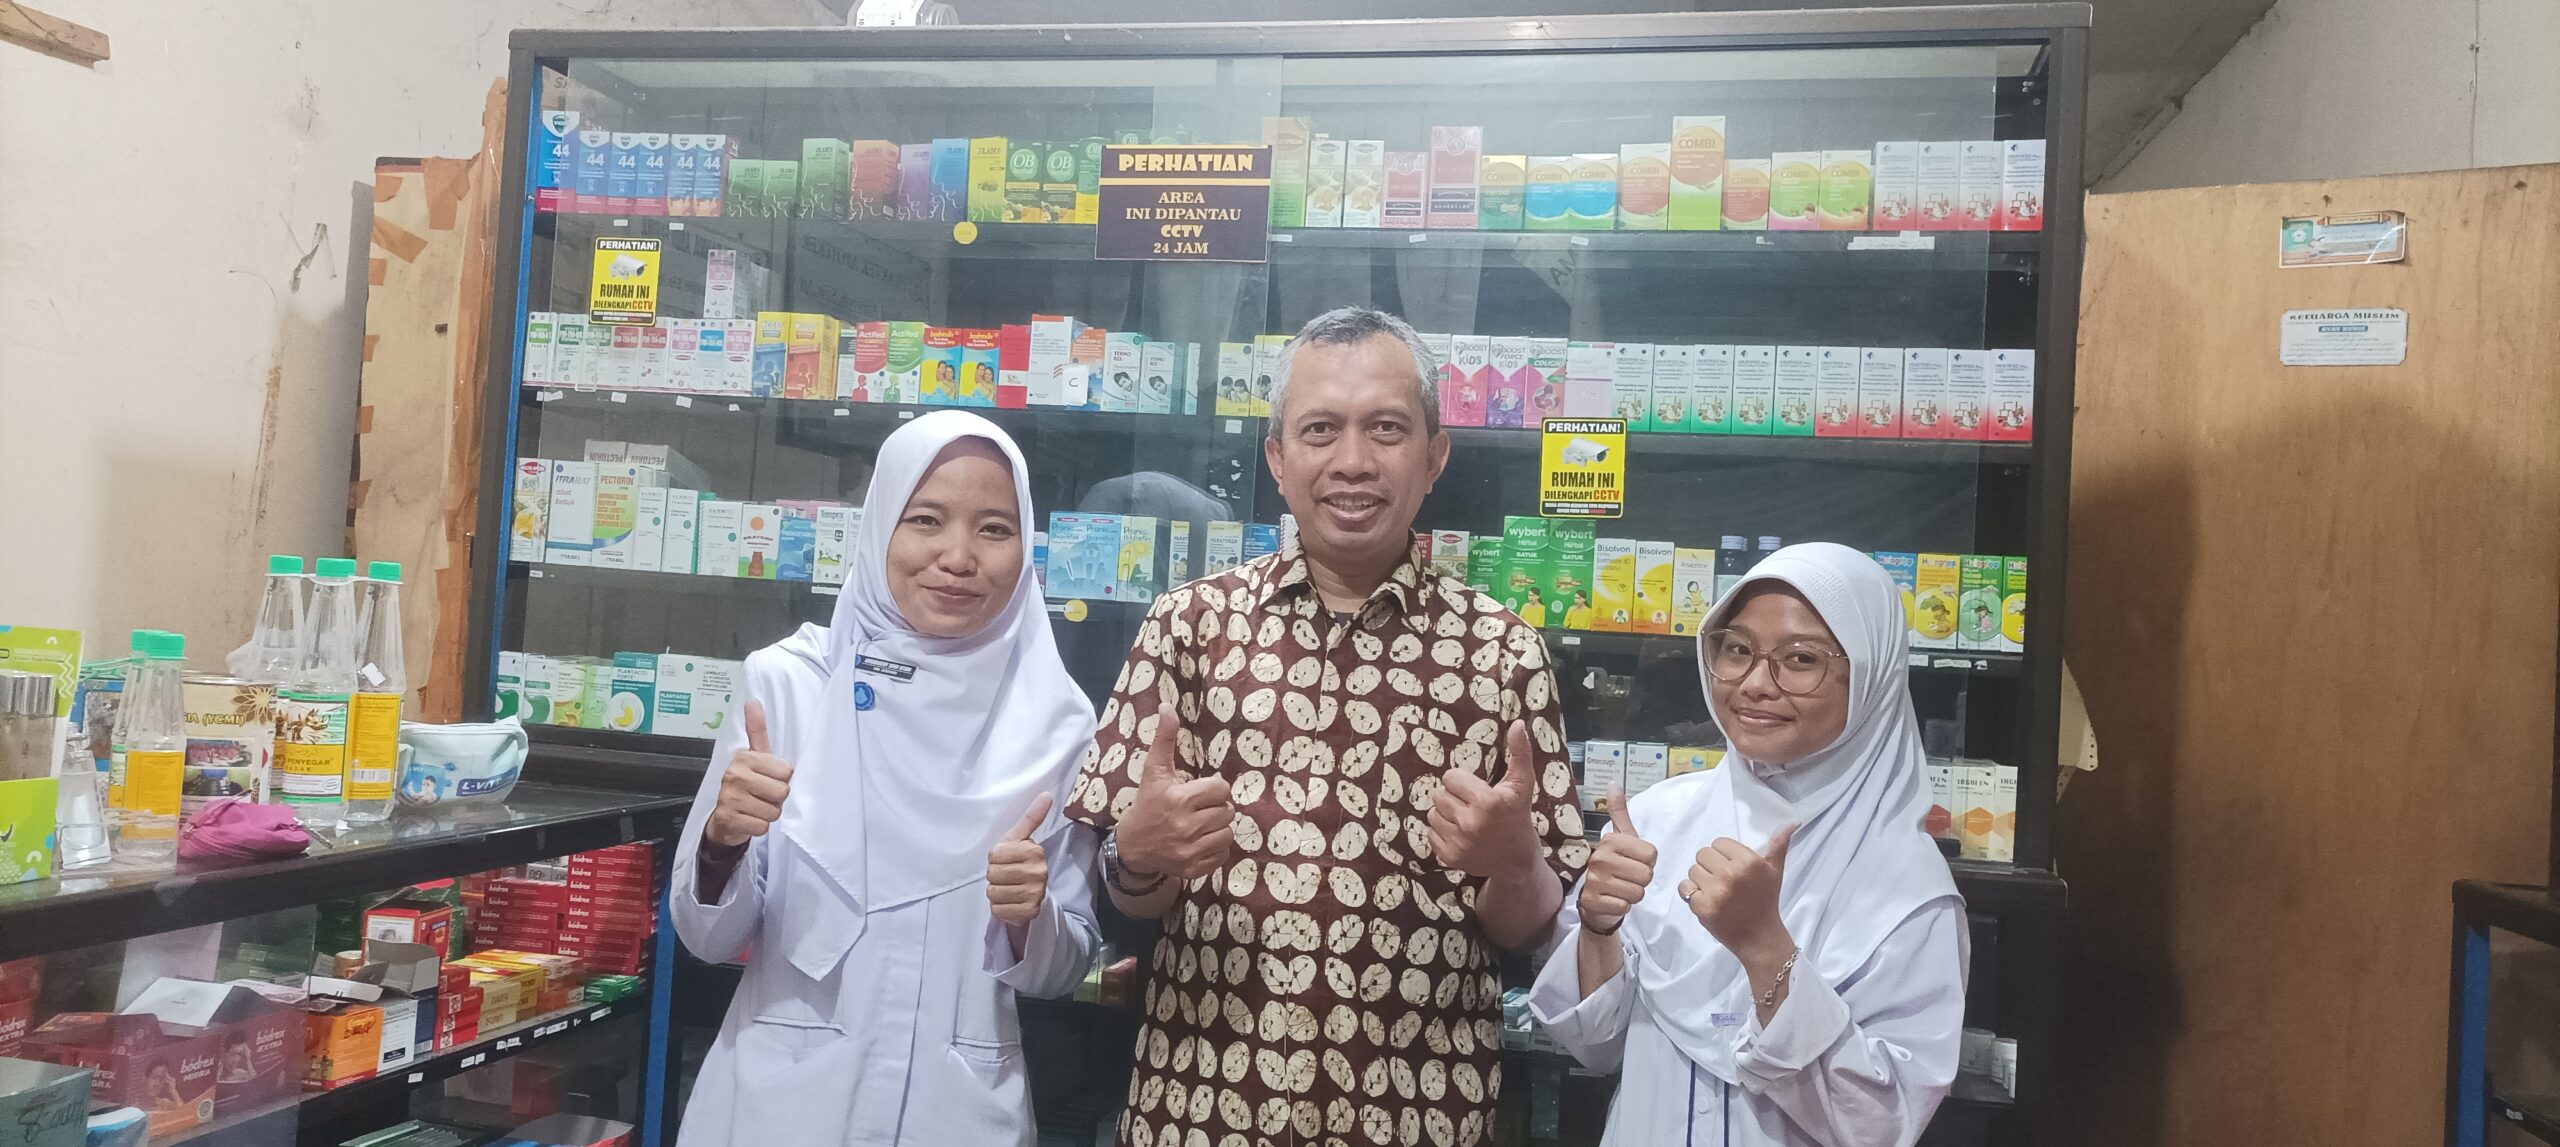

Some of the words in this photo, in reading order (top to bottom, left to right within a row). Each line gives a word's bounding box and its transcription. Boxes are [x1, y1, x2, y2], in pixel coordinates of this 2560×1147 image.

[1678, 139, 1716, 149] COMBI
[552, 144, 570, 157] 44
[586, 154, 605, 166] 44
[618, 155, 635, 168] 44
[646, 155, 664, 168] 44
[677, 156, 694, 169] 44
[704, 157, 721, 169] 44
[1013, 154, 1034, 168] OB
[1051, 155, 1072, 169] OB
[1118, 153, 1253, 172] PERHATIAN
[1630, 167, 1660, 176] COMBI
[1158, 191, 1205, 204] AREA
[1125, 208, 1151, 220] INI
[1154, 208, 1241, 221] DIPANTAU
[1160, 225, 1204, 238] CCTV
[600, 240, 657, 250] PERHATIAN!
[1153, 242, 1169, 254] 24
[1173, 242, 1209, 254] JAM
[600, 284, 635, 298] RUMAH
[636, 285, 651, 299] INI
[593, 300, 632, 309] DILENGKAPI
[632, 300, 653, 310] CCTV
[2353, 312, 2400, 320] MUSLIM
[859, 330, 885, 339] Actifed
[891, 330, 919, 338] Actifed
[1548, 422, 1621, 433] PERHATIAN!
[600, 475, 635, 486] PECTORIN
[1551, 471, 1595, 488] RUMAH
[1597, 472, 1615, 488] INI
[1544, 490, 1593, 500] DILENGKAPI
[1593, 489, 1620, 500] CCTV
[820, 510, 844, 520] Tempra
[1508, 527, 1546, 539] wybert
[1555, 530, 1593, 542] wybert
[1472, 548, 1500, 559] wybert
[1597, 544, 1631, 553] Bisolvon
[1639, 547, 1672, 556] Bisolvon
[202, 713, 245, 728] (YCMI)
[287, 758, 330, 766] PENYEGAR
